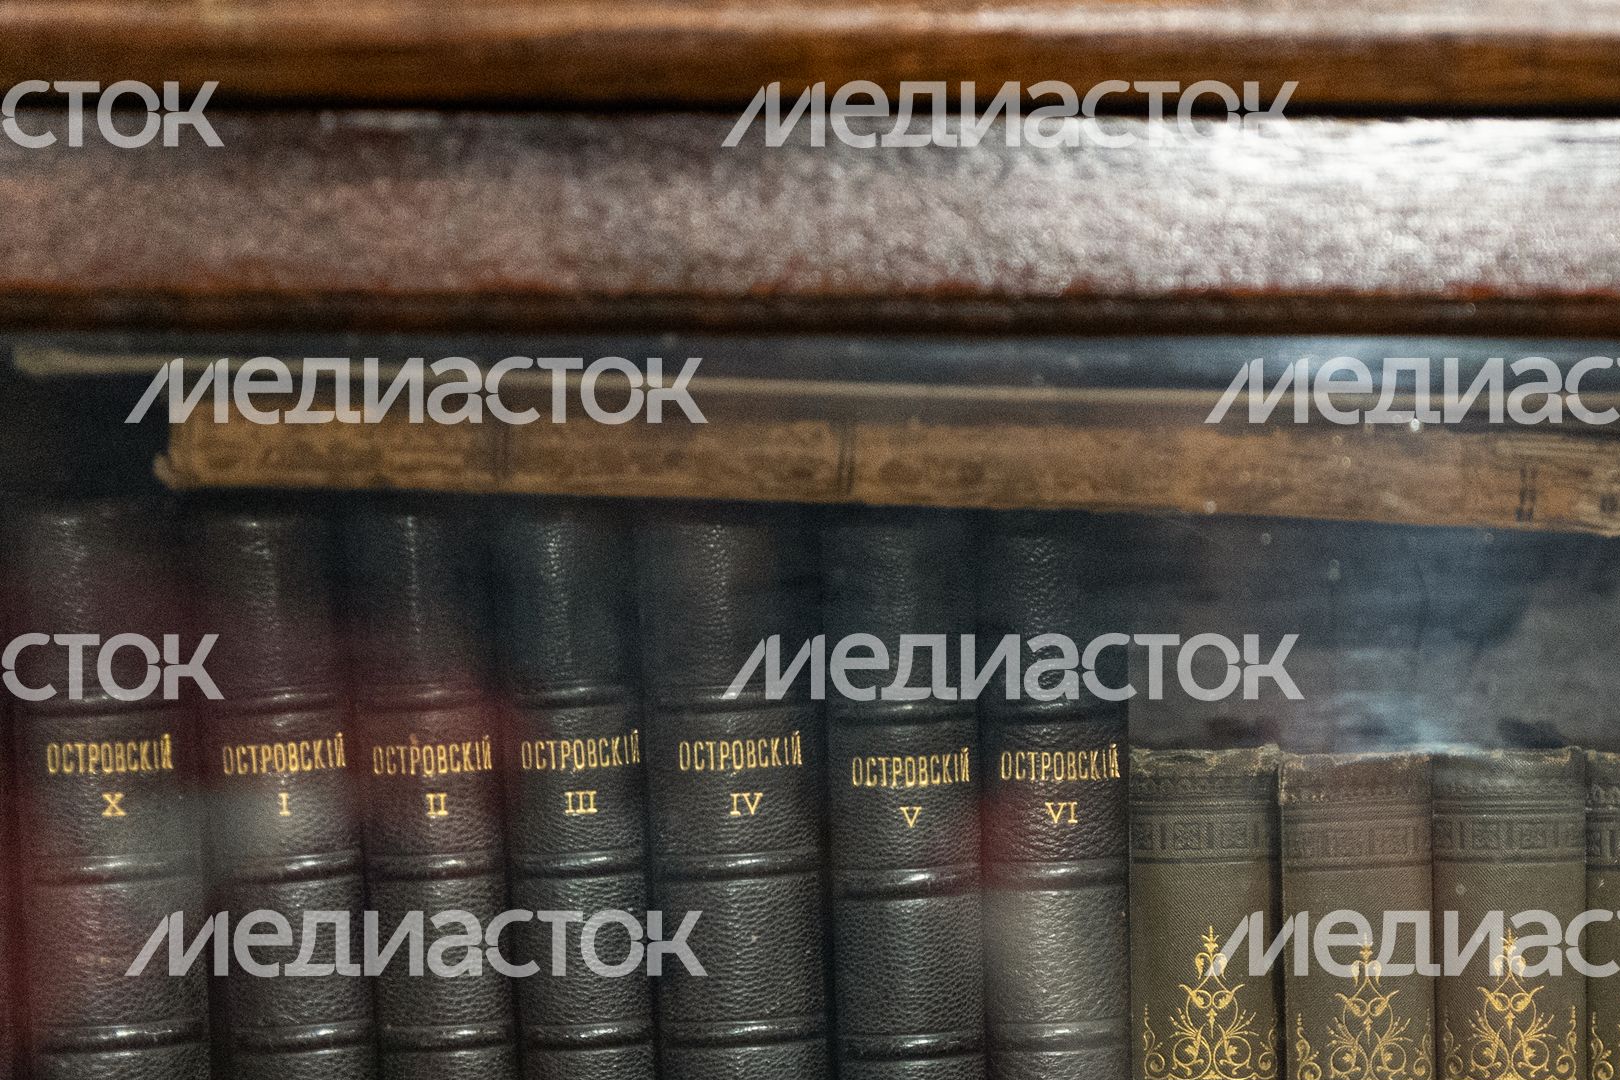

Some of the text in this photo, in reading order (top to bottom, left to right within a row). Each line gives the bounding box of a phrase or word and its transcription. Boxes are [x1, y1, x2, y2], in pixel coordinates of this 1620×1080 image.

[101, 792, 126, 817] X
[279, 792, 291, 816] I
[425, 792, 449, 816] II
[564, 790, 597, 814] III
[729, 791, 763, 816] IV
[1045, 801, 1079, 825] VI
[900, 806, 922, 828] V
